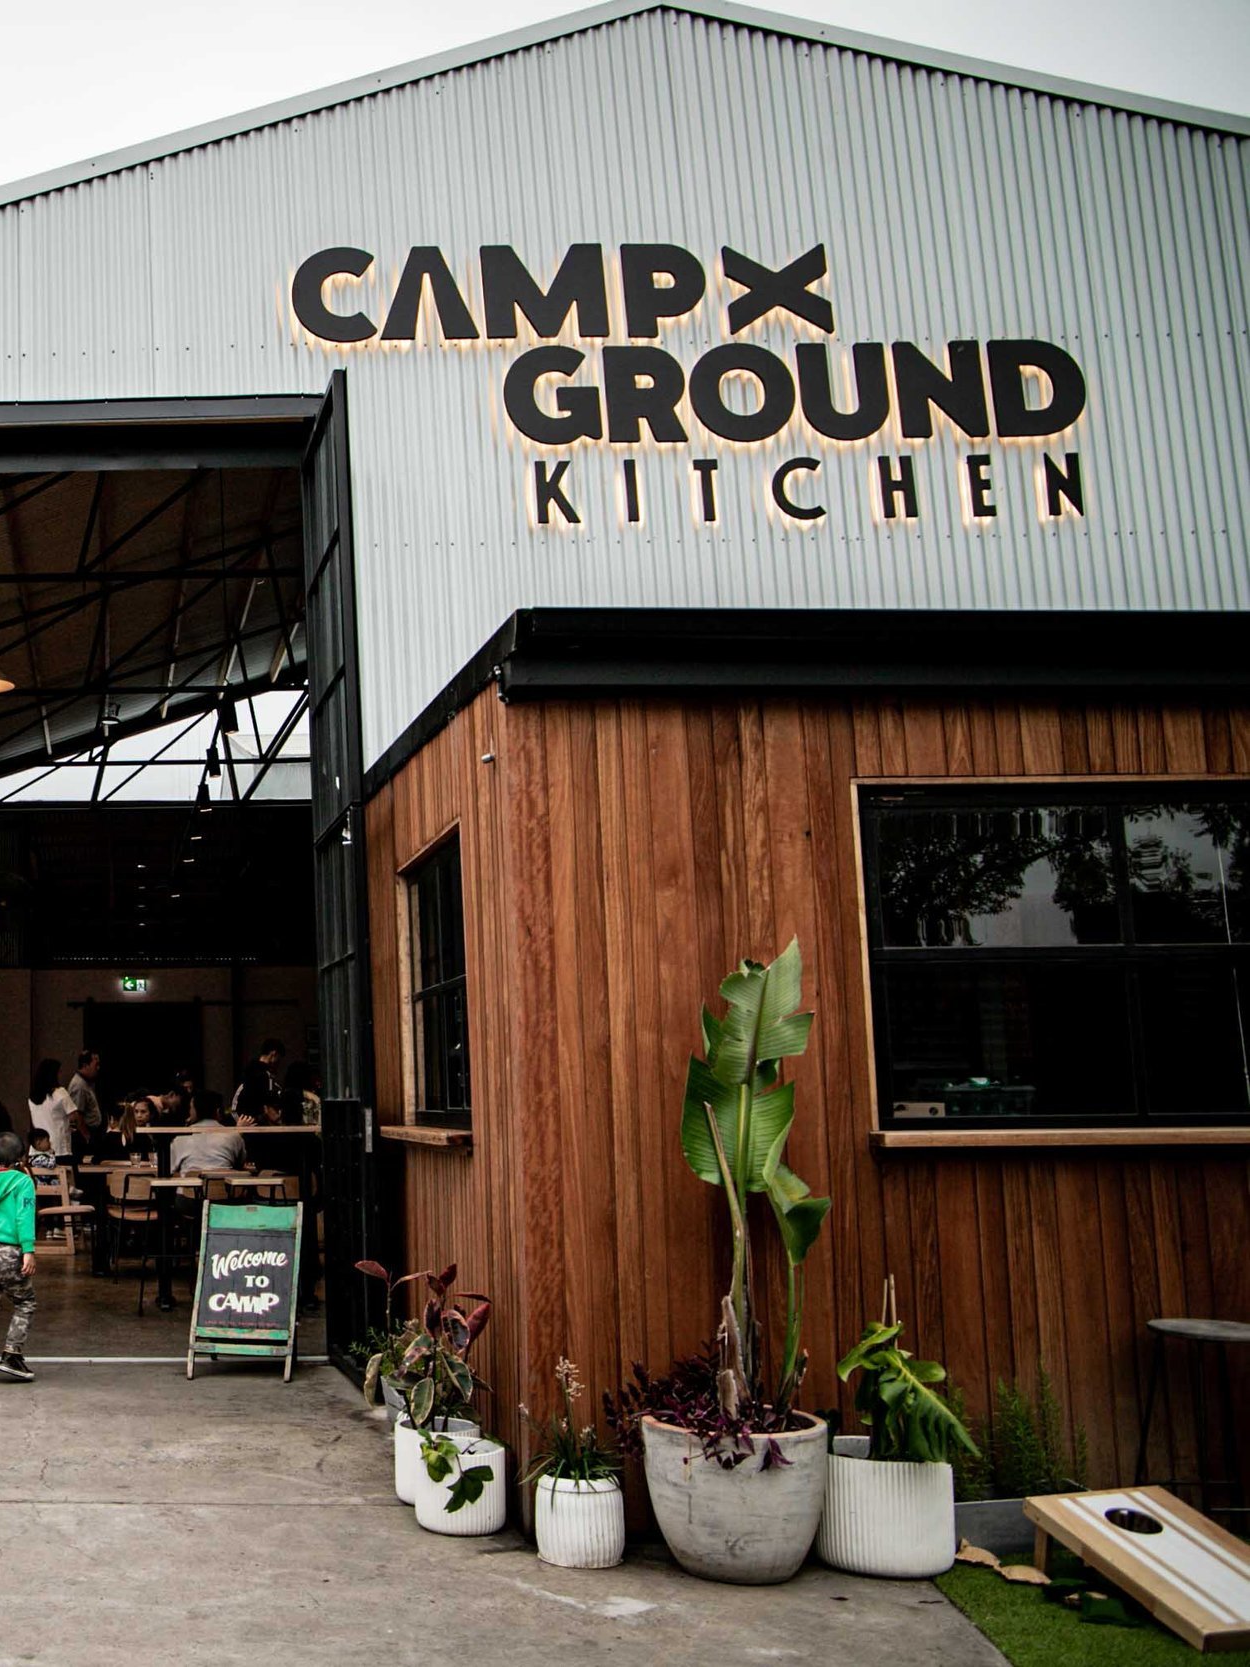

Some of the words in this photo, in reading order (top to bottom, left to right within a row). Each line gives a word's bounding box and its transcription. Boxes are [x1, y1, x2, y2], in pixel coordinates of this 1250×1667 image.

[503, 338, 1087, 446] GROUND
[534, 452, 1085, 525] KITCHEN
[211, 1249, 288, 1279] Welcome
[244, 1275, 270, 1288] TO
[208, 1292, 280, 1314] CAMP
